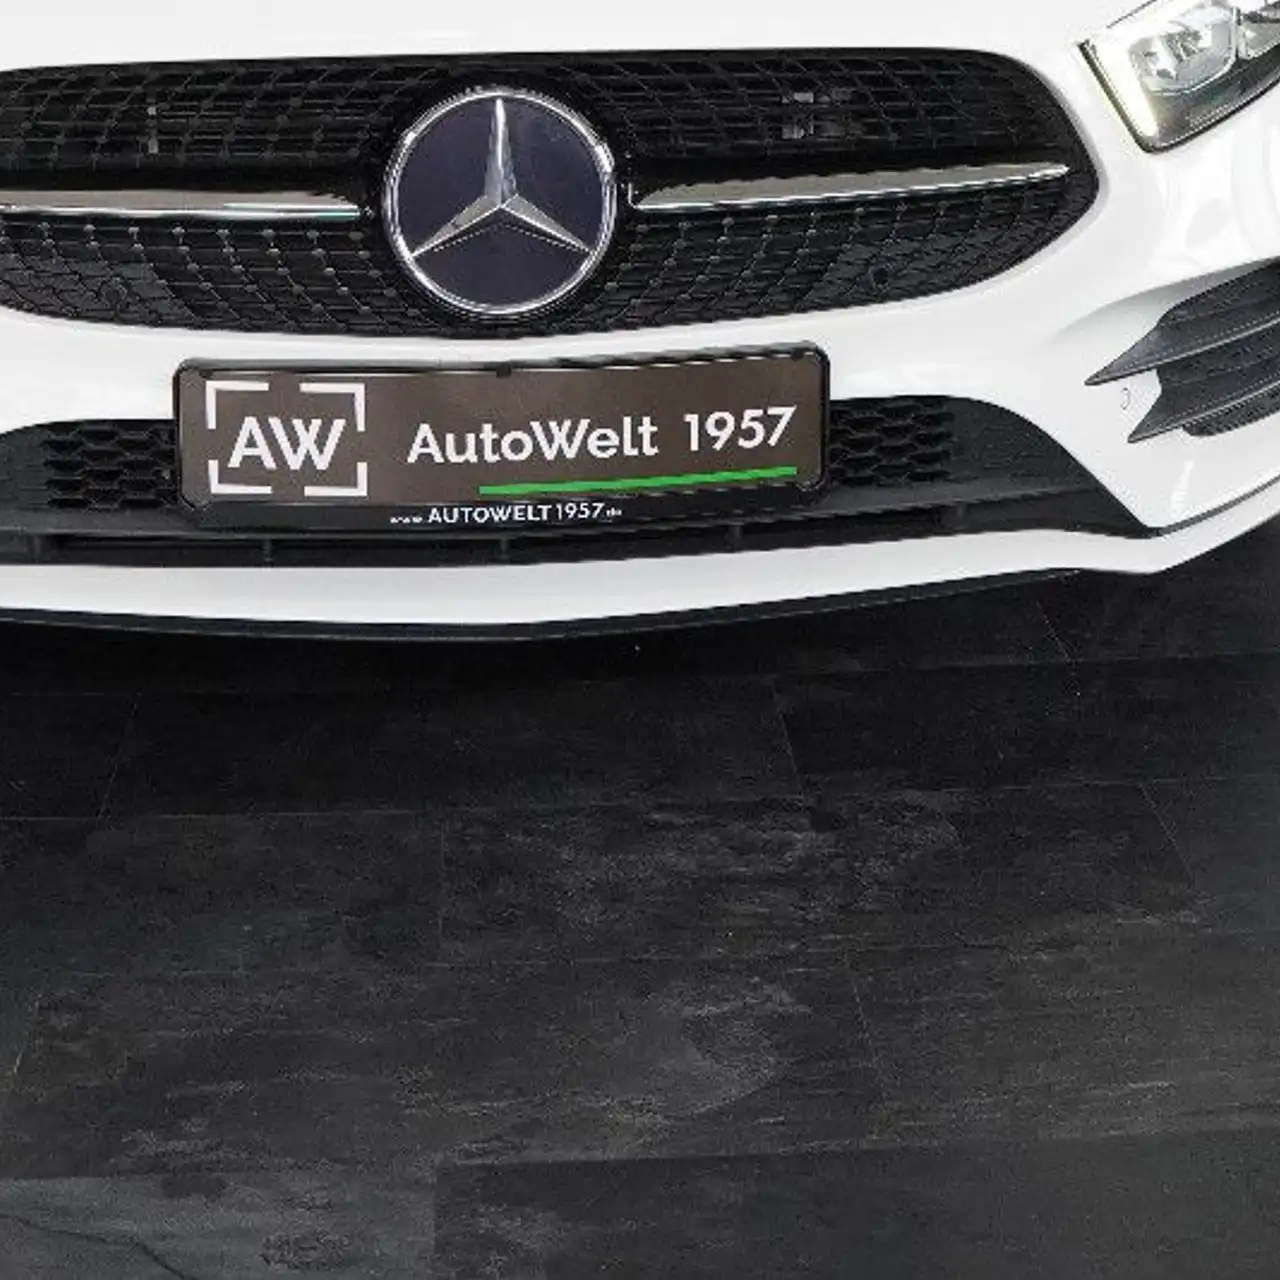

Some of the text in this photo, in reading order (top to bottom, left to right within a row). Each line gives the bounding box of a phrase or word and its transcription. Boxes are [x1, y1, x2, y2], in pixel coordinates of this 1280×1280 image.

[227, 416, 346, 471] AW
[407, 406, 797, 465] AutoWelt 1957
